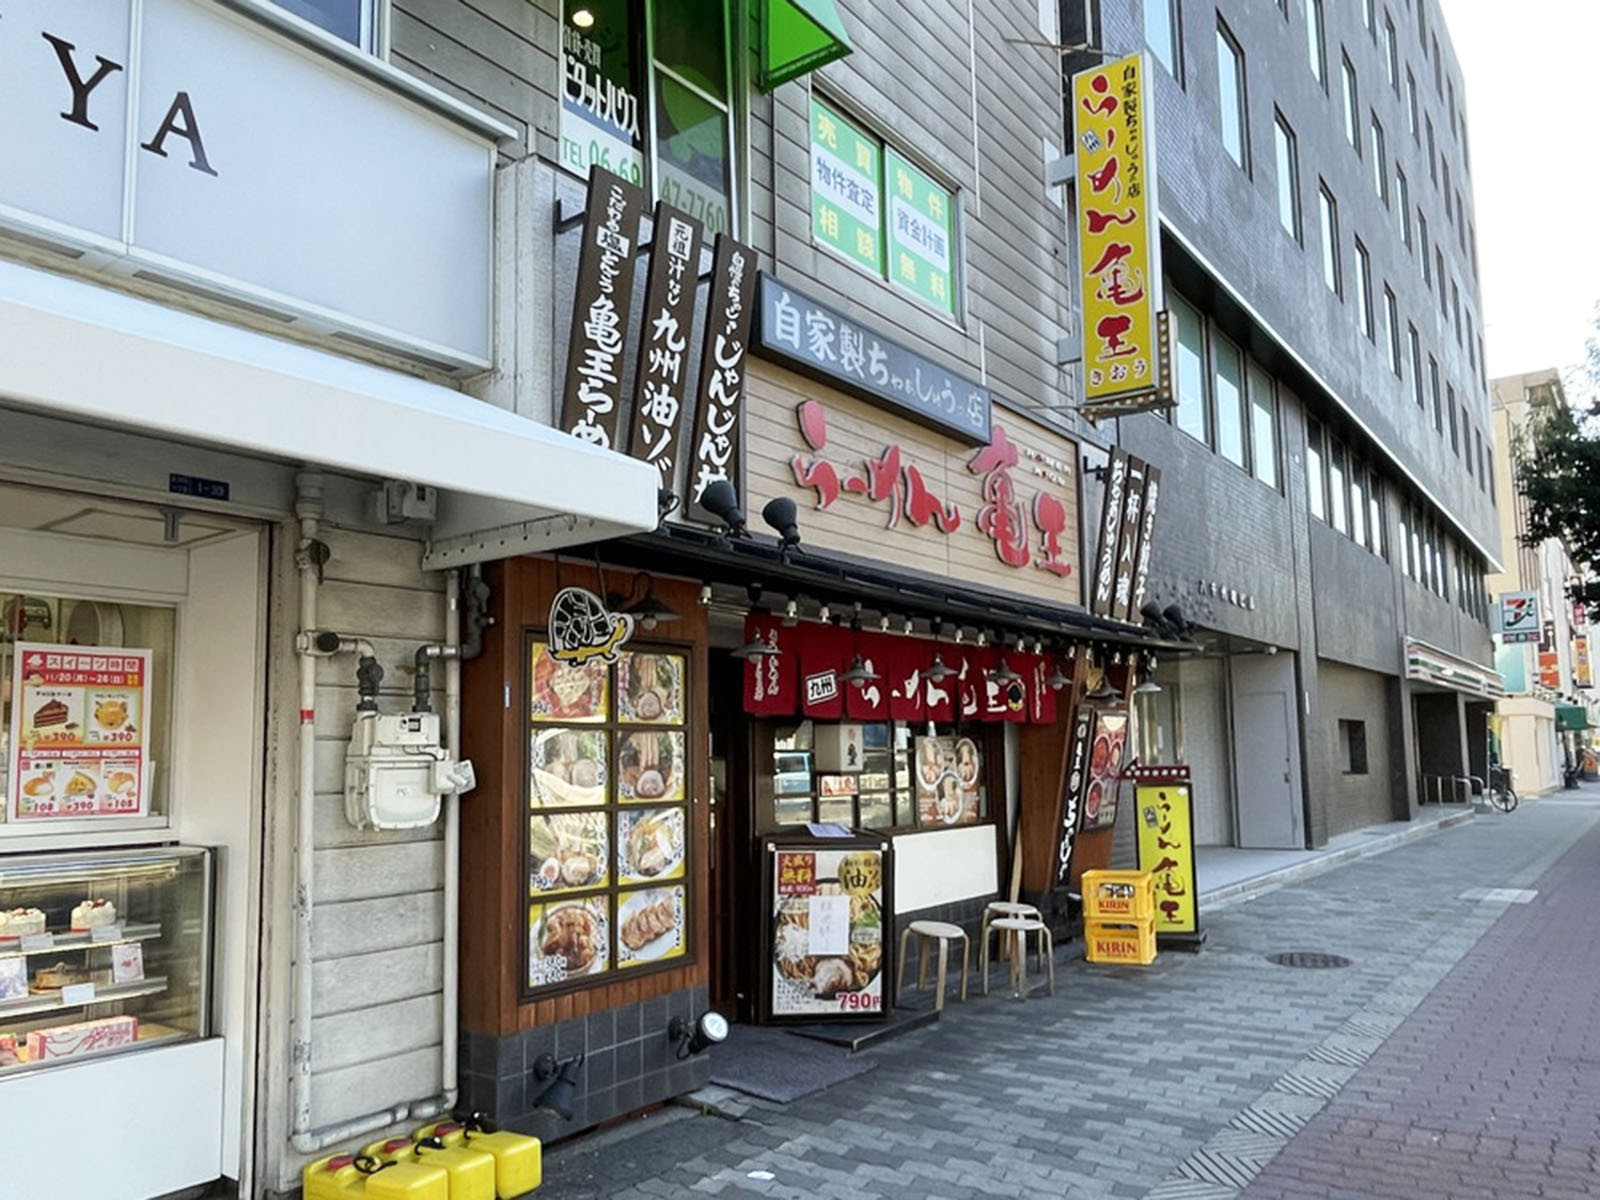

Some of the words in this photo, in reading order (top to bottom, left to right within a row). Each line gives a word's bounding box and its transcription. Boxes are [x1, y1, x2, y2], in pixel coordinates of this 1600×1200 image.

[562, 137, 585, 170] TEL
[816, 156, 875, 216] 物件査定
[896, 207, 946, 260] 資金計画
[48, 656, 139, 671] スイーツ時間
[809, 675, 834, 698] 九州
[780, 868, 813, 884] 無料
[1099, 900, 1129, 909] KIRIN
[1096, 941, 1137, 954] KIRIN
